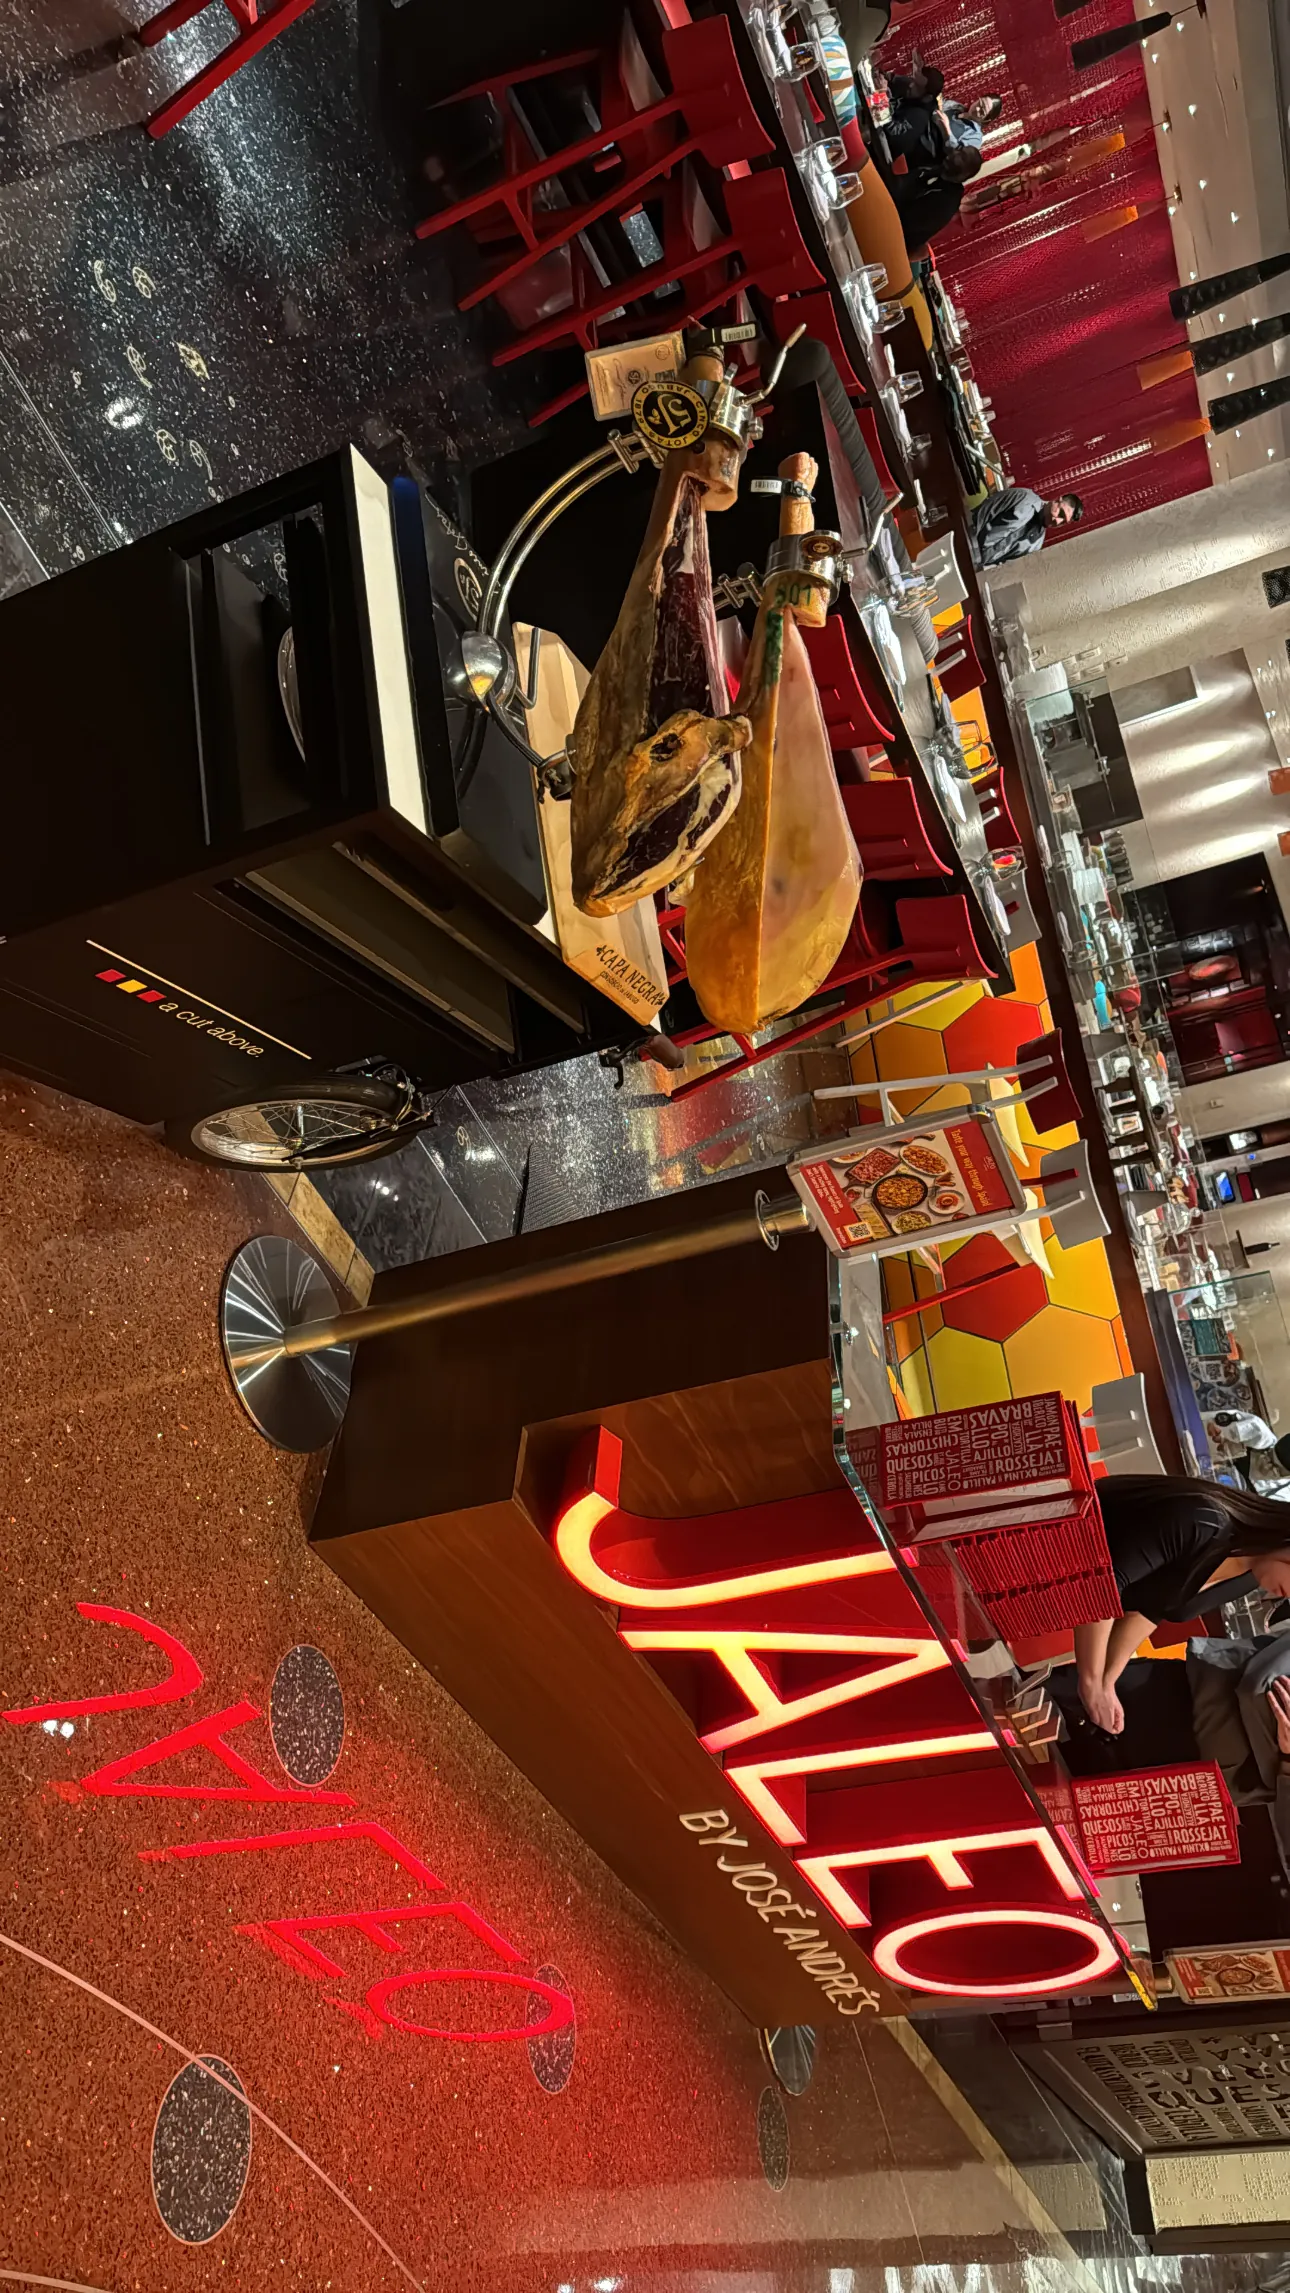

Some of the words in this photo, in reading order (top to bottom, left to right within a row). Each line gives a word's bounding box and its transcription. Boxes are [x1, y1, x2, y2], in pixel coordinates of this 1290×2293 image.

[693, 400, 706, 437] CINCO
[600, 949, 630, 978] CAPA
[625, 970, 663, 1005] NEGRA
[158, 1002, 179, 1013] a
[176, 1010, 215, 1029] cut
[207, 1026, 265, 1058] above.
[950, 1128, 964, 1144] Taste
[955, 1144, 968, 1157] your
[960, 1157, 973, 1169] way
[965, 1168, 985, 1191] through
[946, 1414, 962, 1432] EM
[968, 1401, 1032, 1428] BRAVAS
[970, 1426, 990, 1449] LLO
[989, 1423, 1008, 1440] PO
[1024, 1429, 1044, 1452] LLA
[1042, 1426, 1062, 1448] PAE
[885, 1432, 958, 1458] CHISTORRAS
[958, 1430, 972, 1464] TORTILLA
[973, 1444, 1011, 1462] AJILLO
[886, 1451, 933, 1474] QUESOS
[944, 1448, 962, 1491] JALEO
[994, 1447, 1064, 1474] ROSSEJAT
[912, 1465, 945, 1484] PICOS
[886, 1474, 897, 1500] CEBOLLA
[922, 1481, 939, 1495] LO
[555, 1488, 1125, 1997] JALEO
[1143, 1773, 1197, 1795] BRAVAS
[1079, 1798, 1140, 1818] CHISTORRAS
[1138, 1797, 1153, 1831] TORTILLA
[1192, 1803, 1211, 1825] LLA
[1207, 1801, 1225, 1822] PAE
[1082, 1817, 1122, 1836] QUESOS
[1153, 1815, 1184, 1830] AJILLO
[1106, 1832, 1134, 1847] PICOS
[1130, 1814, 1149, 1859] JALEO
[1172, 1824, 1229, 1844] ROSSEJAT
[678, 1807, 749, 1850] BY
[715, 1852, 817, 1923] JOSÉ
[772, 1922, 881, 2018] ANDRÉS
